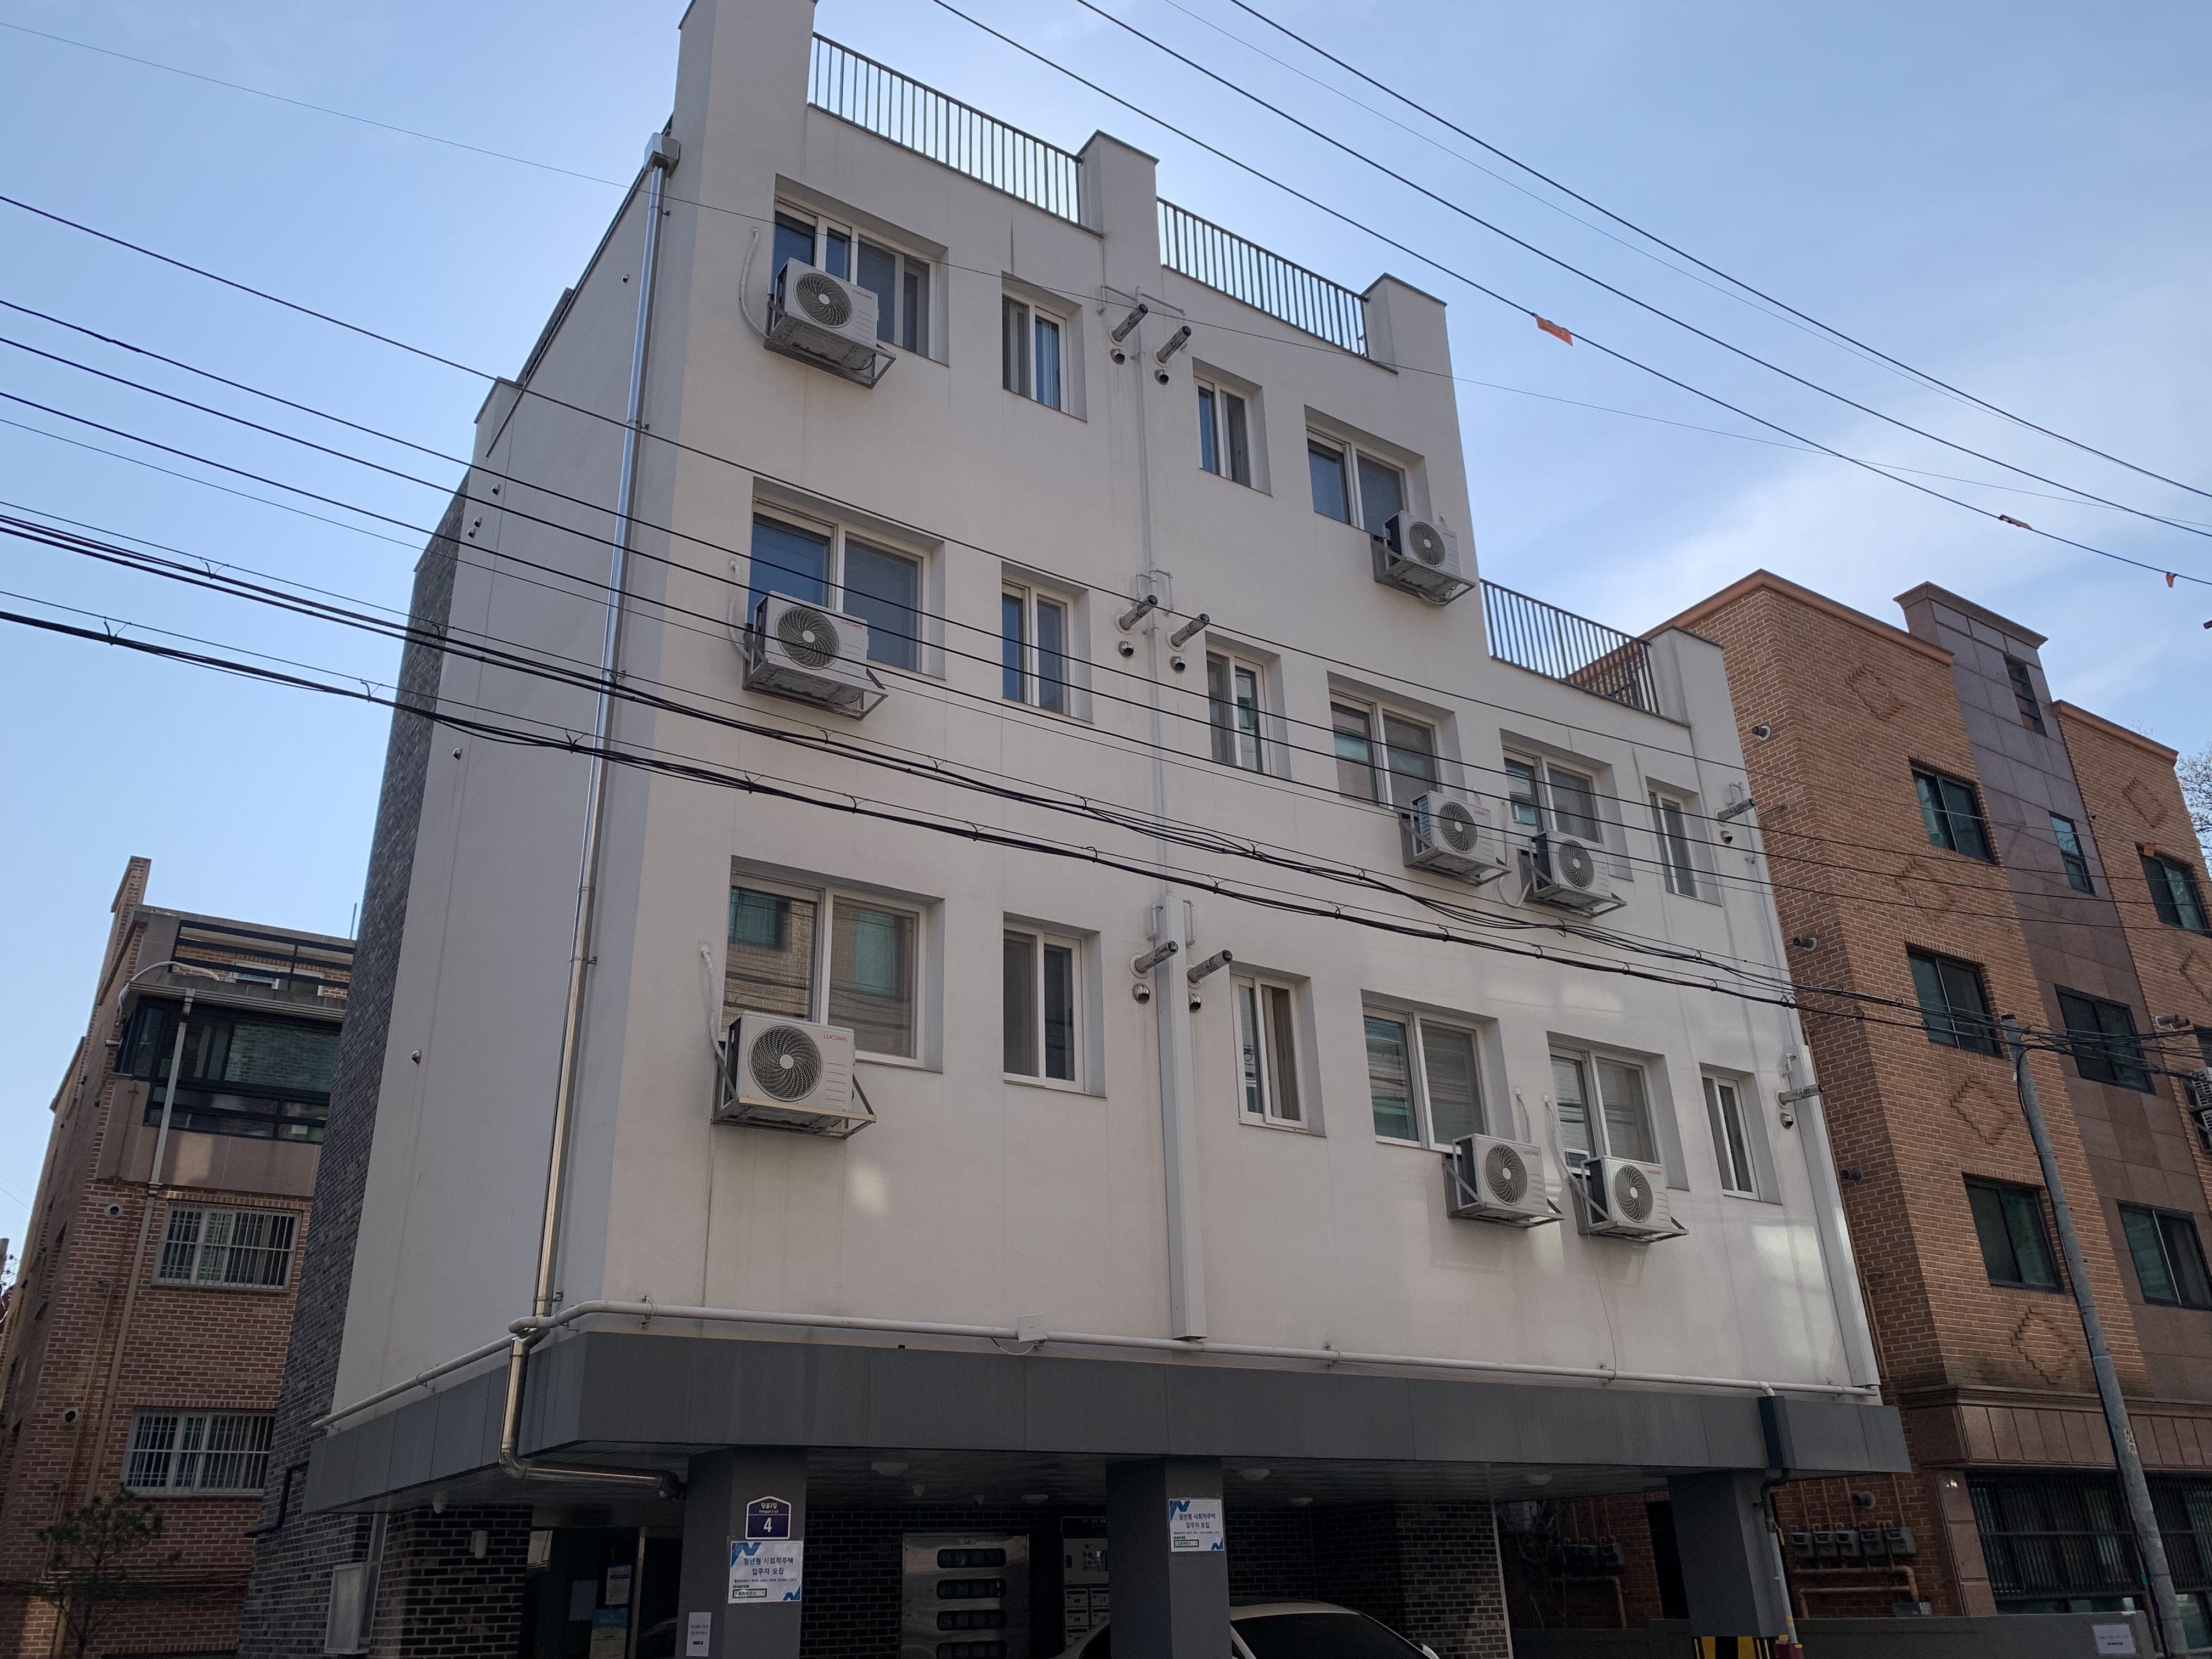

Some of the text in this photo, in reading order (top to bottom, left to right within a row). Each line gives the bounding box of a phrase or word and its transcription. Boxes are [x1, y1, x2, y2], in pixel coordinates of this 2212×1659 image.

[853, 289, 872, 300] LUCOMS
[840, 619, 862, 629] LUCOMS
[823, 1034, 848, 1042] LUCOMS
[763, 1517, 772, 1532] 4
[743, 1557, 761, 1565] 청년형
[752, 1567, 770, 1576] 입주자
